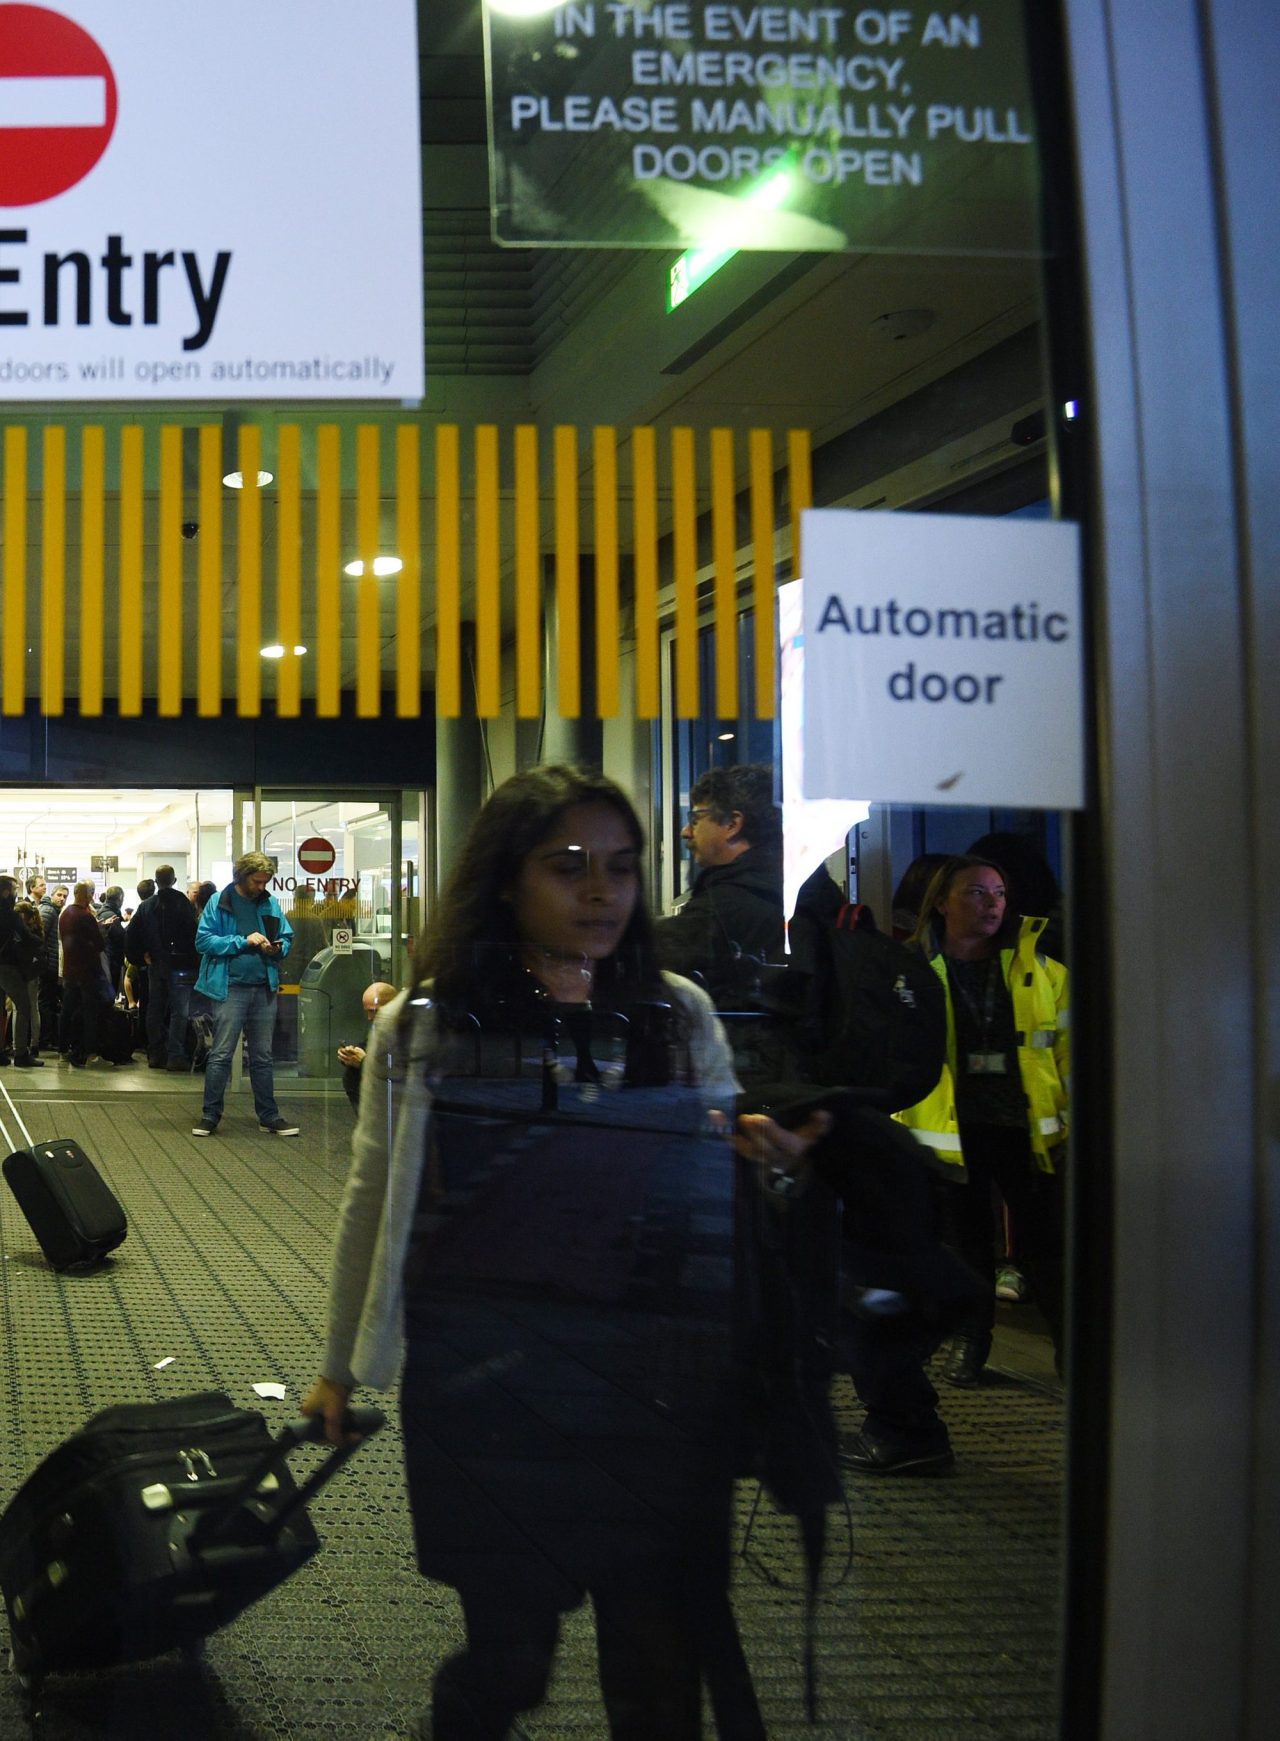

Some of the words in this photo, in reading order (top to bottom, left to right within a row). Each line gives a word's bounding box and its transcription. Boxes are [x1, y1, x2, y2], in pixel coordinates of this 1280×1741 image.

[553, 0, 596, 38] IN
[607, 0, 694, 40] THE
[704, 2, 843, 43] EVENT
[854, 8, 914, 45] OF
[921, 10, 982, 49] AN
[631, 48, 913, 96] EMERGENCY,
[511, 95, 682, 133] PLEASE
[691, 98, 917, 139] MANUALLY
[926, 104, 1032, 144] PULL
[803, 148, 923, 187] OPEN
[78, 357, 126, 383] will
[133, 362, 201, 386] open
[210, 356, 396, 385] automatically
[816, 593, 1070, 644] Automatic
[887, 661, 1004, 704] door
[272, 876, 297, 891] NO
[305, 877, 361, 893] ENTRY
